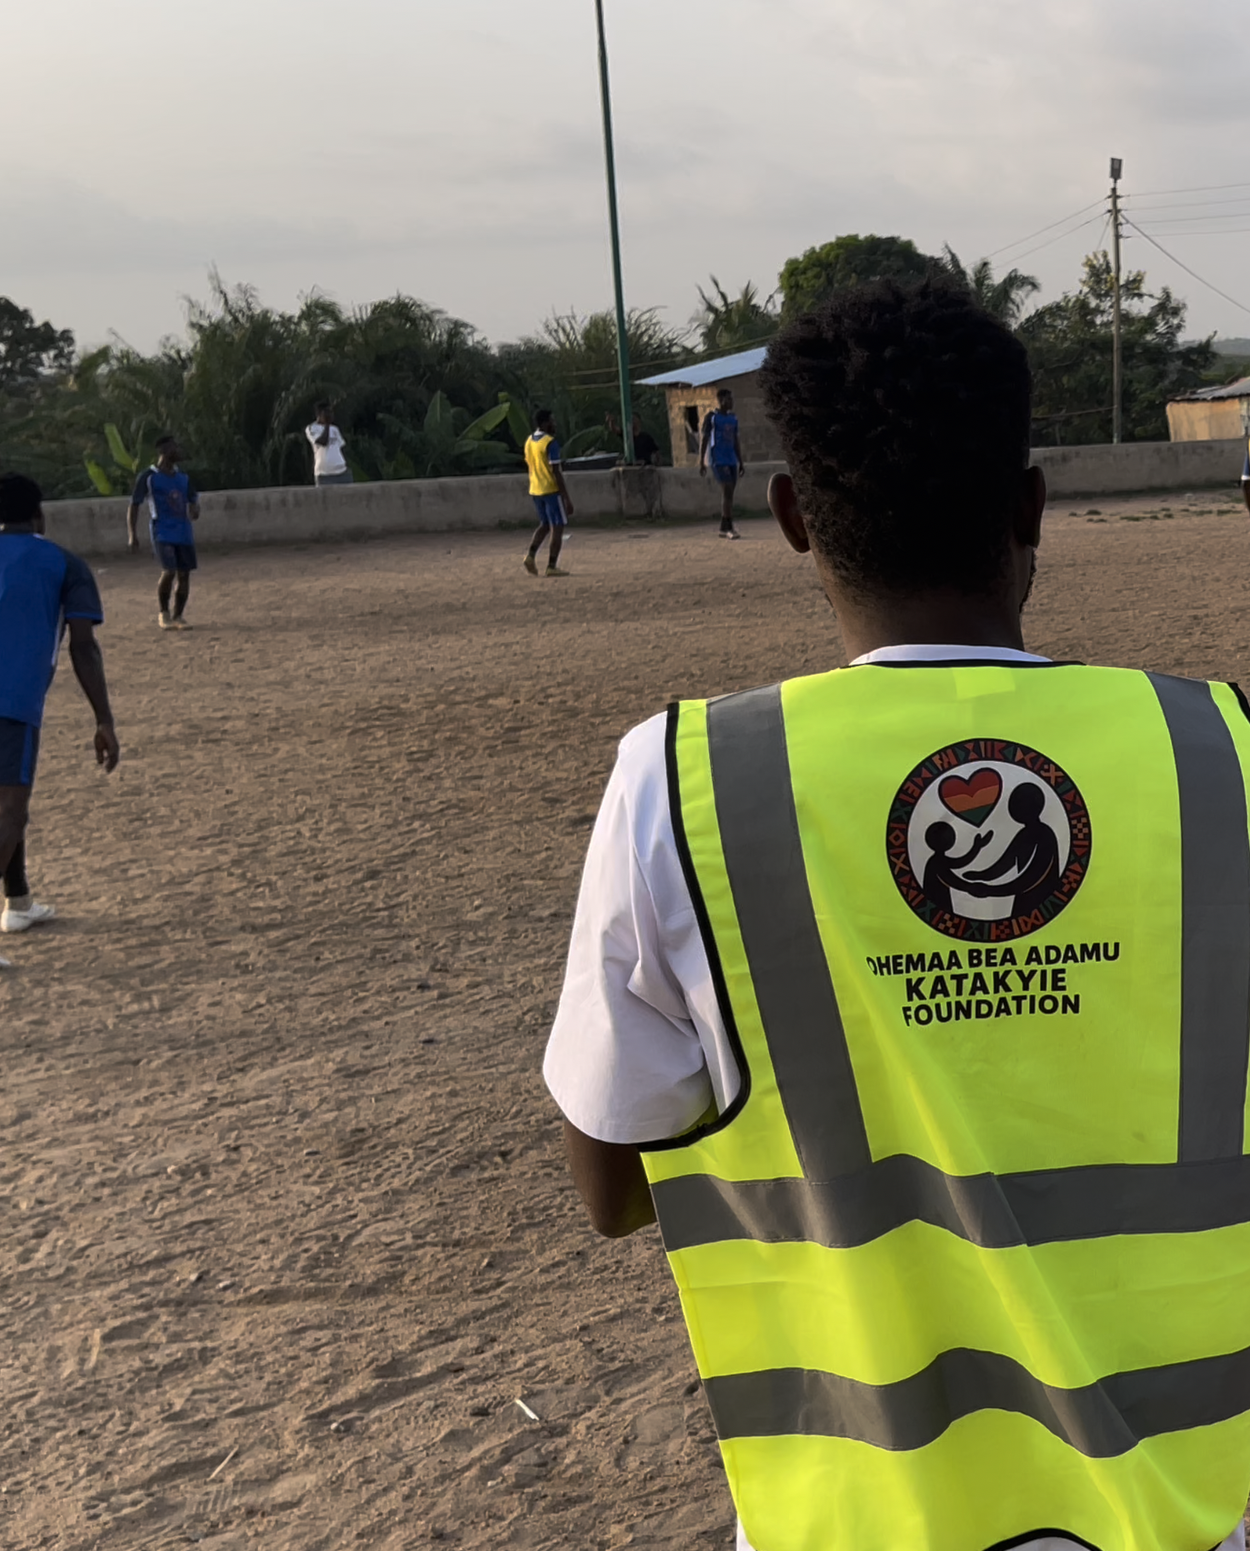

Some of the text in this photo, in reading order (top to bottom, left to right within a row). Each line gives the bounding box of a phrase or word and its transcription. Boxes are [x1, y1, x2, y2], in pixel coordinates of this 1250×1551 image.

[968, 947, 1018, 968] BEA
[1024, 942, 1120, 966] ADAMU
[905, 968, 1067, 1002] KATAKYIE
[902, 994, 1080, 1027] FOUNDATION
